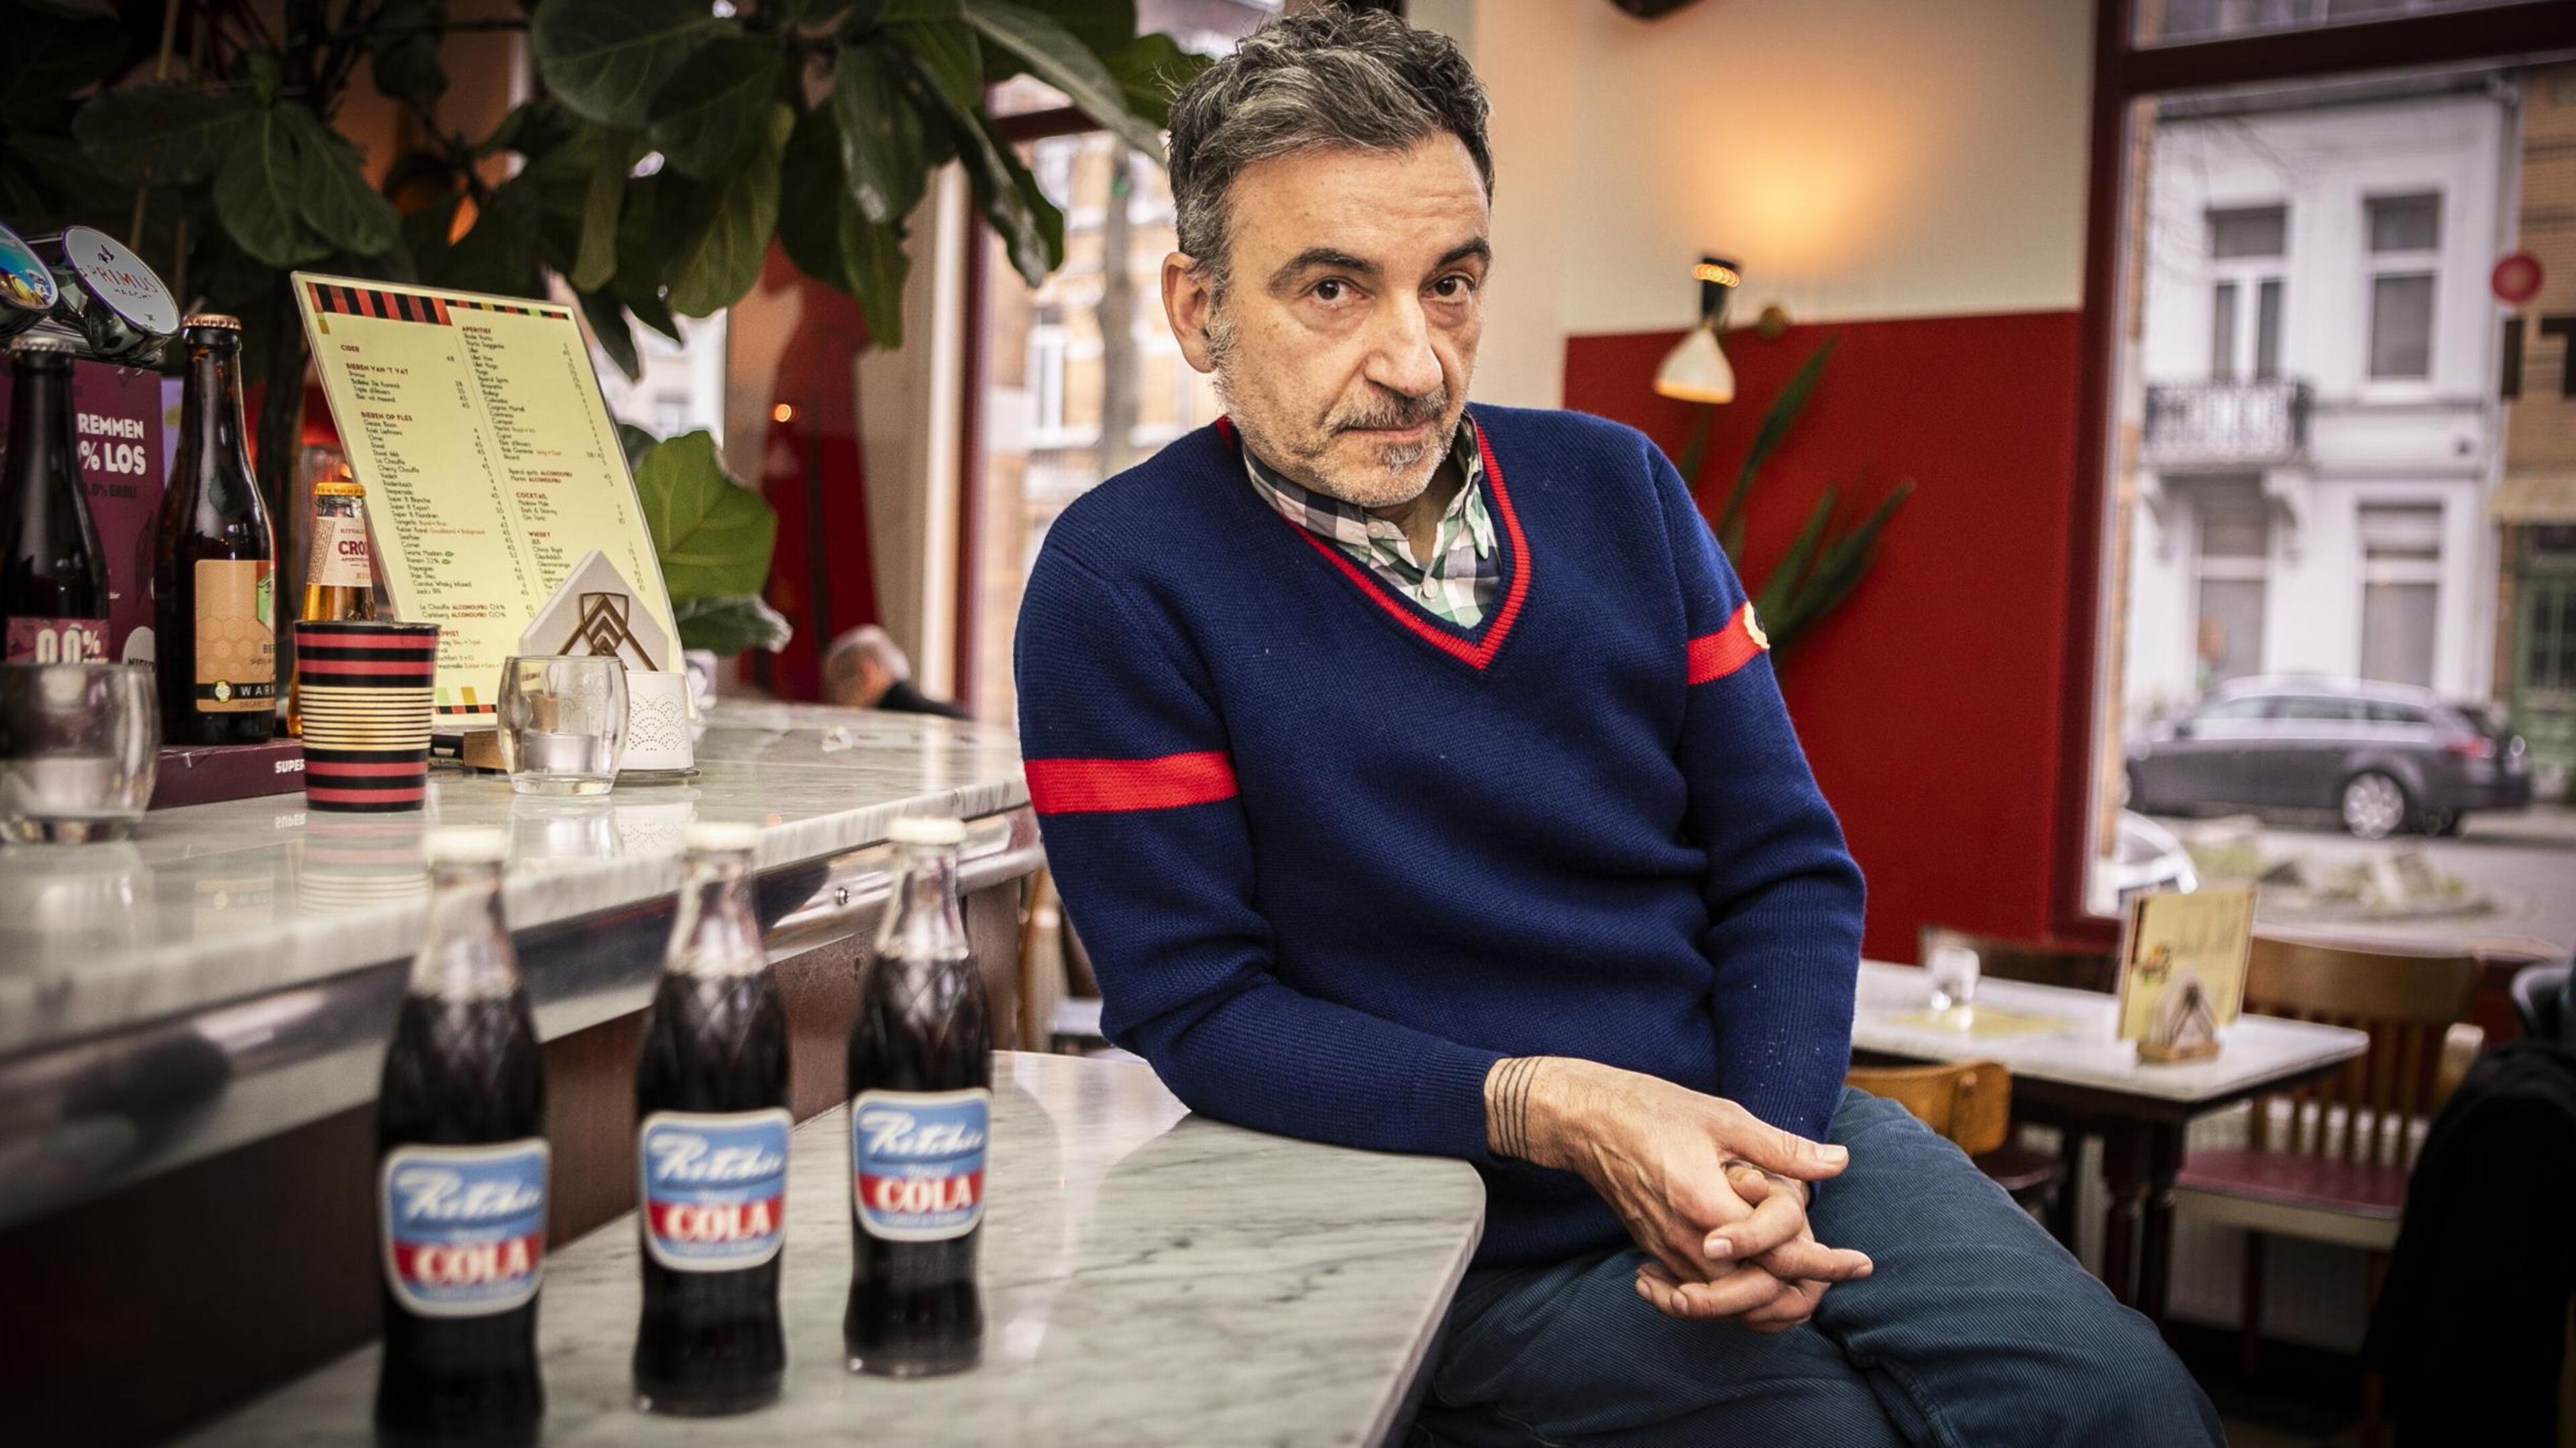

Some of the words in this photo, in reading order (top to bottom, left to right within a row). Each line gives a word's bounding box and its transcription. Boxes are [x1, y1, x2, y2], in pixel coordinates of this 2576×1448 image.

[104, 442, 146, 476] LOS
[338, 541, 368, 556] CRO
[275, 759, 305, 774] SUPER
[875, 1172, 973, 1213] COLA
[665, 1199, 770, 1242] COLA
[416, 1236, 533, 1284] COLA
